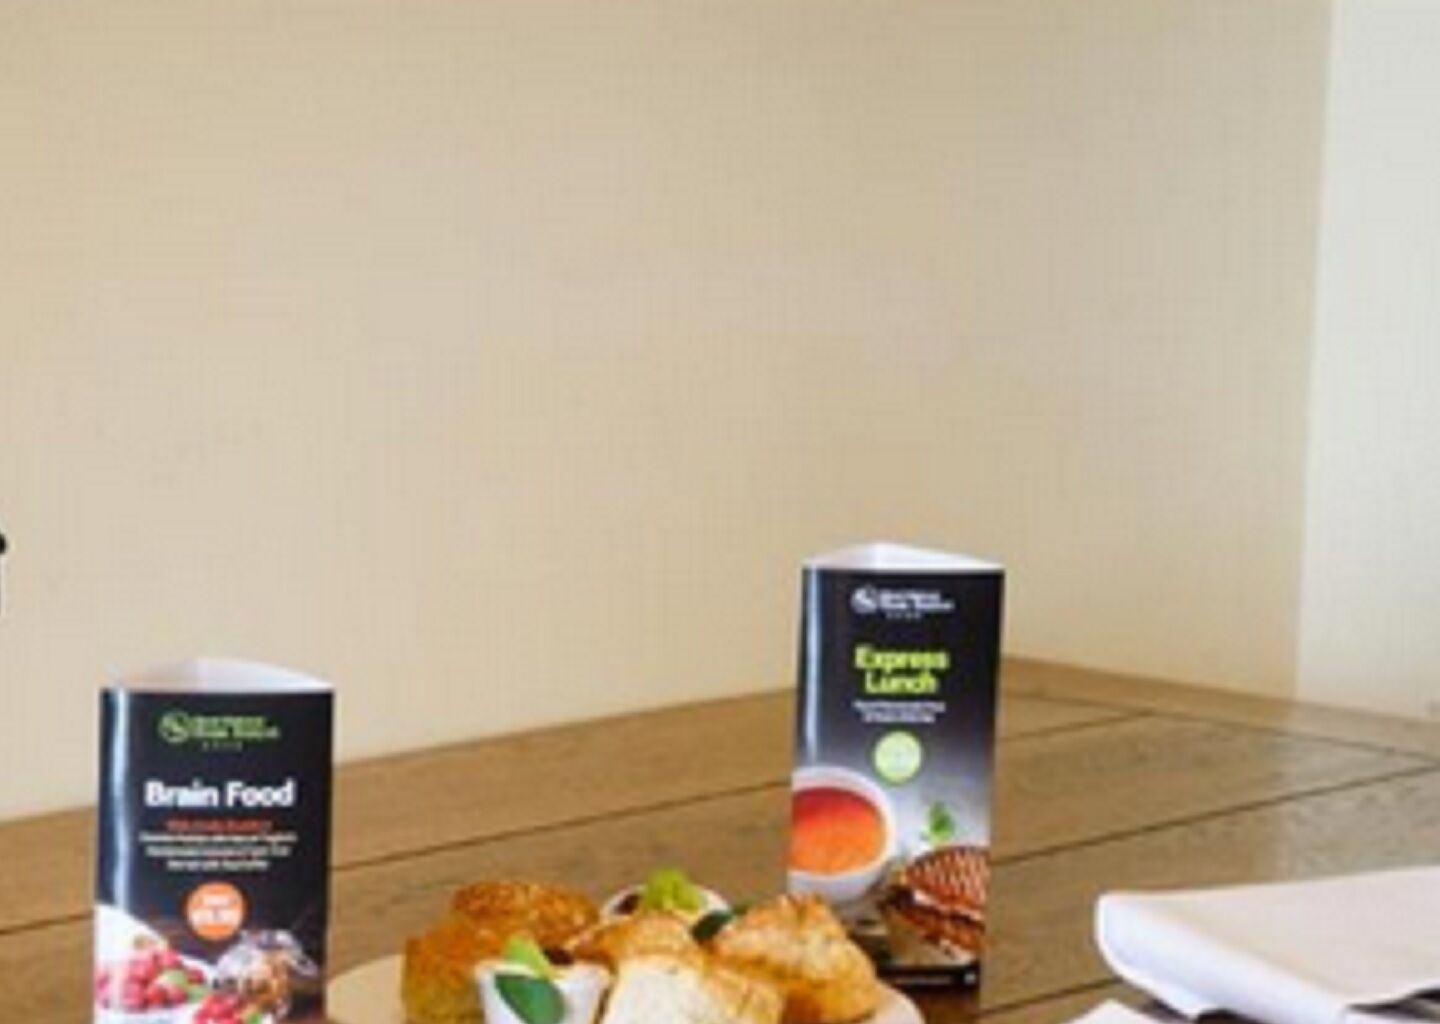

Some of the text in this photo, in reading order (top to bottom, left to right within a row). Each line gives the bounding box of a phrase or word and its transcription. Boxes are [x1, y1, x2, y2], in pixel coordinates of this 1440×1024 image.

[854, 645, 949, 673] Express
[865, 669, 939, 694] Lunch
[144, 777, 295, 807] Brain Food
